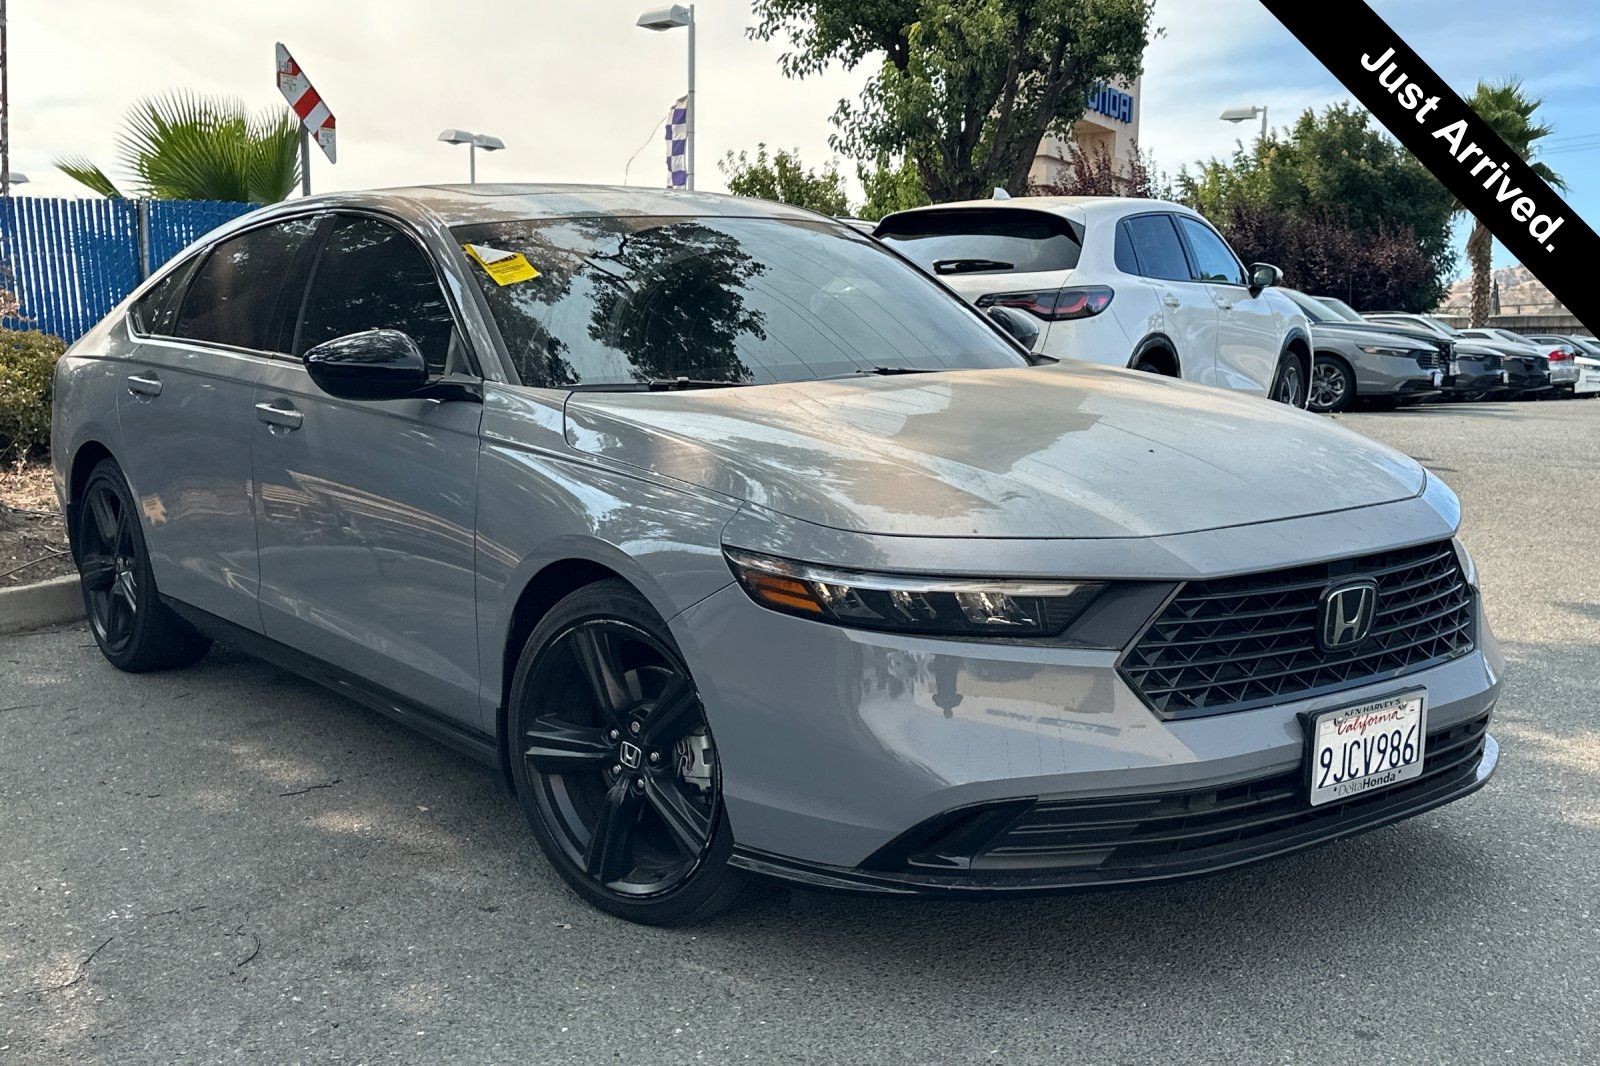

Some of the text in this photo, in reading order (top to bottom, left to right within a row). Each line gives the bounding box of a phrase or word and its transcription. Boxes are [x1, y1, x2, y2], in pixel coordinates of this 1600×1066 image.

[1338, 711, 1404, 735] California
[1344, 708, 1361, 717] KEN
[1317, 724, 1416, 789] 9JCV986
